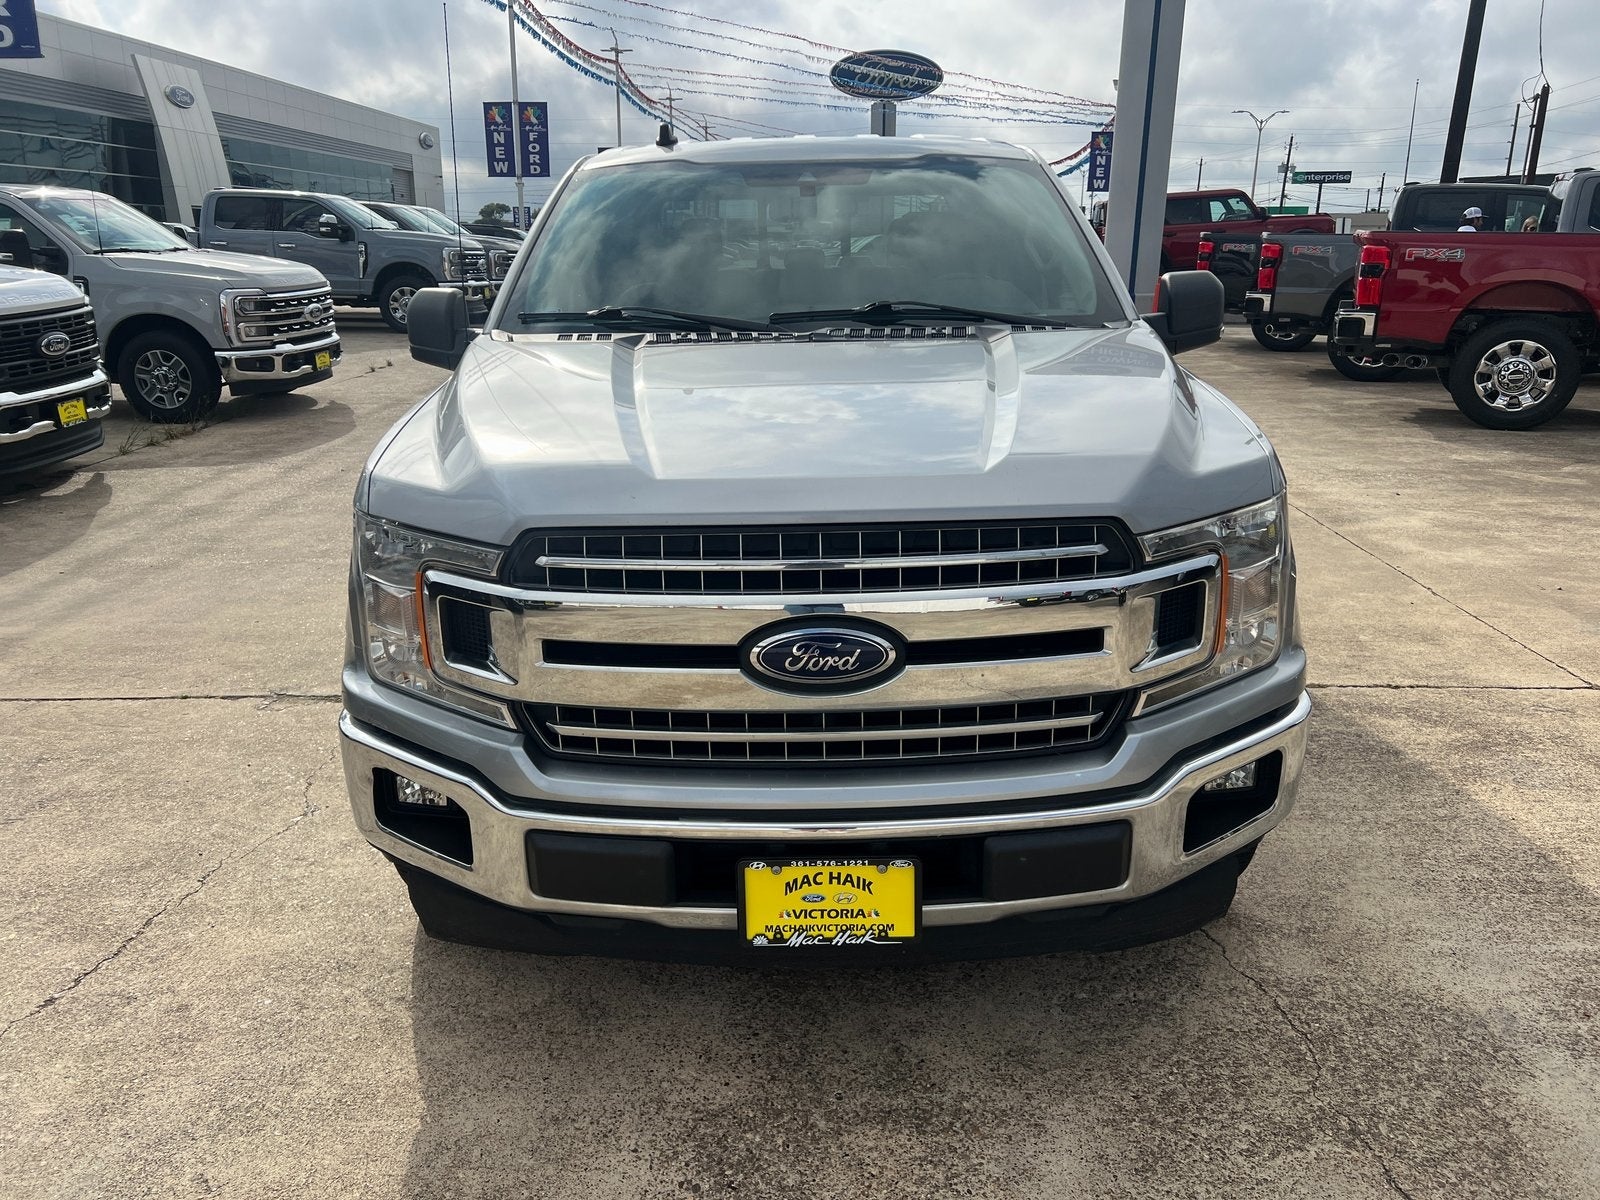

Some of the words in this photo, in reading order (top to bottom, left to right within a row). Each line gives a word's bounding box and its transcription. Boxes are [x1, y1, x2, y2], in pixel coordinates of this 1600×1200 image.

[493, 132, 509, 173] NEW
[528, 132, 541, 174] FORD
[1093, 155, 1106, 189] NEW
[1296, 172, 1351, 182] enterprise
[1223, 243, 1255, 252] FX4
[1292, 245, 1333, 255] FX4
[1405, 247, 1465, 262] FX4
[50, 338, 65, 351] Ford
[785, 640, 861, 671] Ford
[893, 860, 910, 868] Ford
[784, 872, 824, 896] MAC
[828, 872, 874, 895] HAIK
[792, 908, 867, 919] VICTORIA
[786, 930, 829, 948] Mac
[831, 929, 878, 946] Haik
